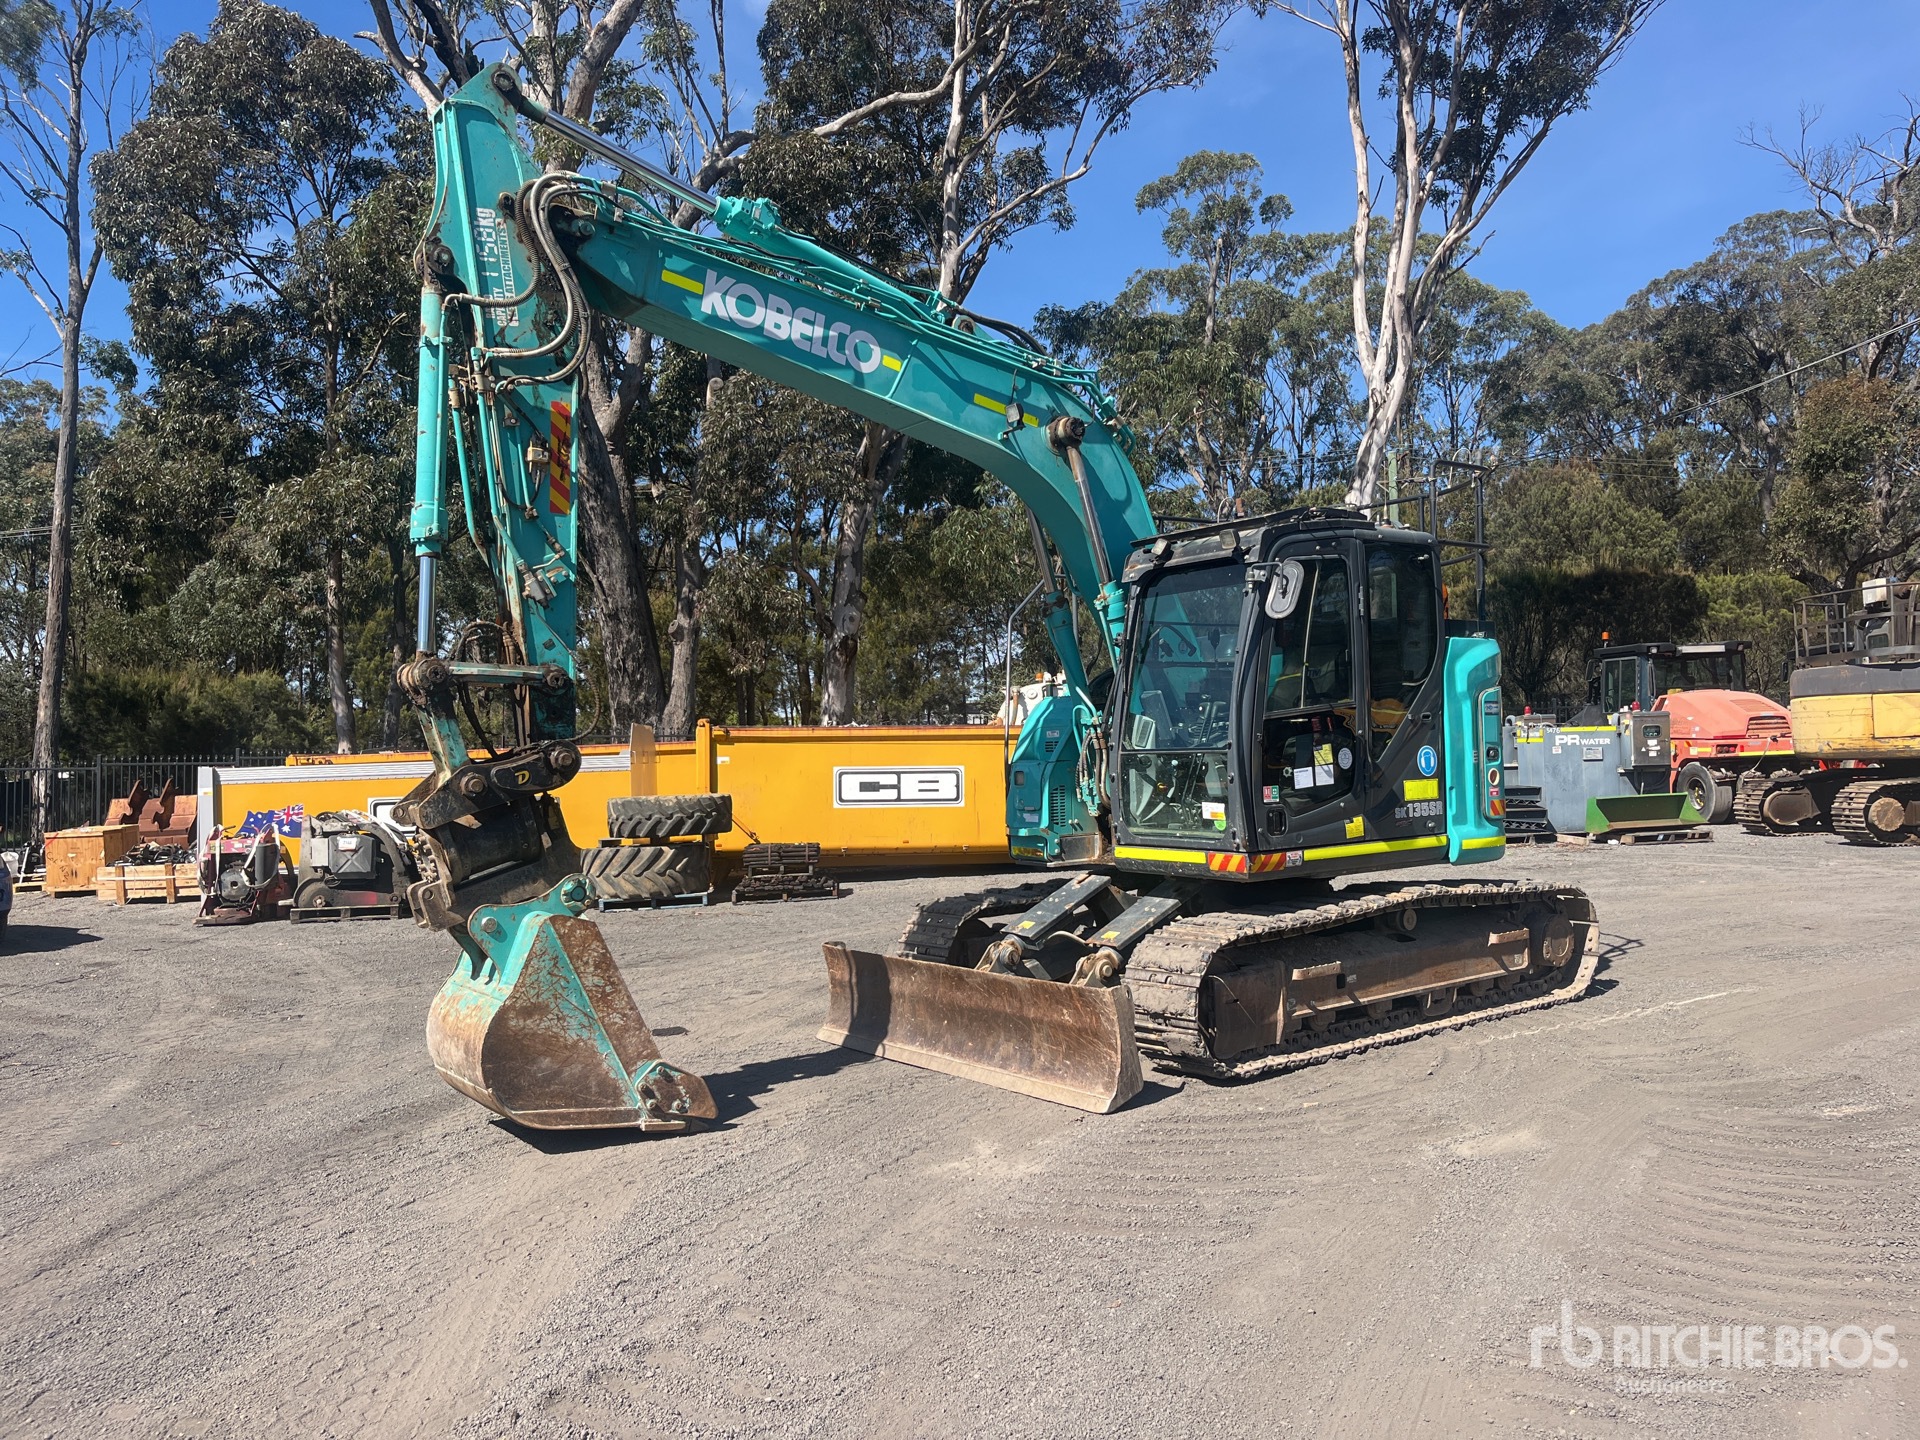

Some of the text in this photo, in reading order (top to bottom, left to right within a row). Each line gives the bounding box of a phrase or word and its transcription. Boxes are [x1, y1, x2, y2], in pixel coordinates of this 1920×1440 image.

[497, 227, 514, 295] ATTACHMENTS
[701, 269, 881, 374] KOBELCO
[1555, 735, 1580, 746] PR
